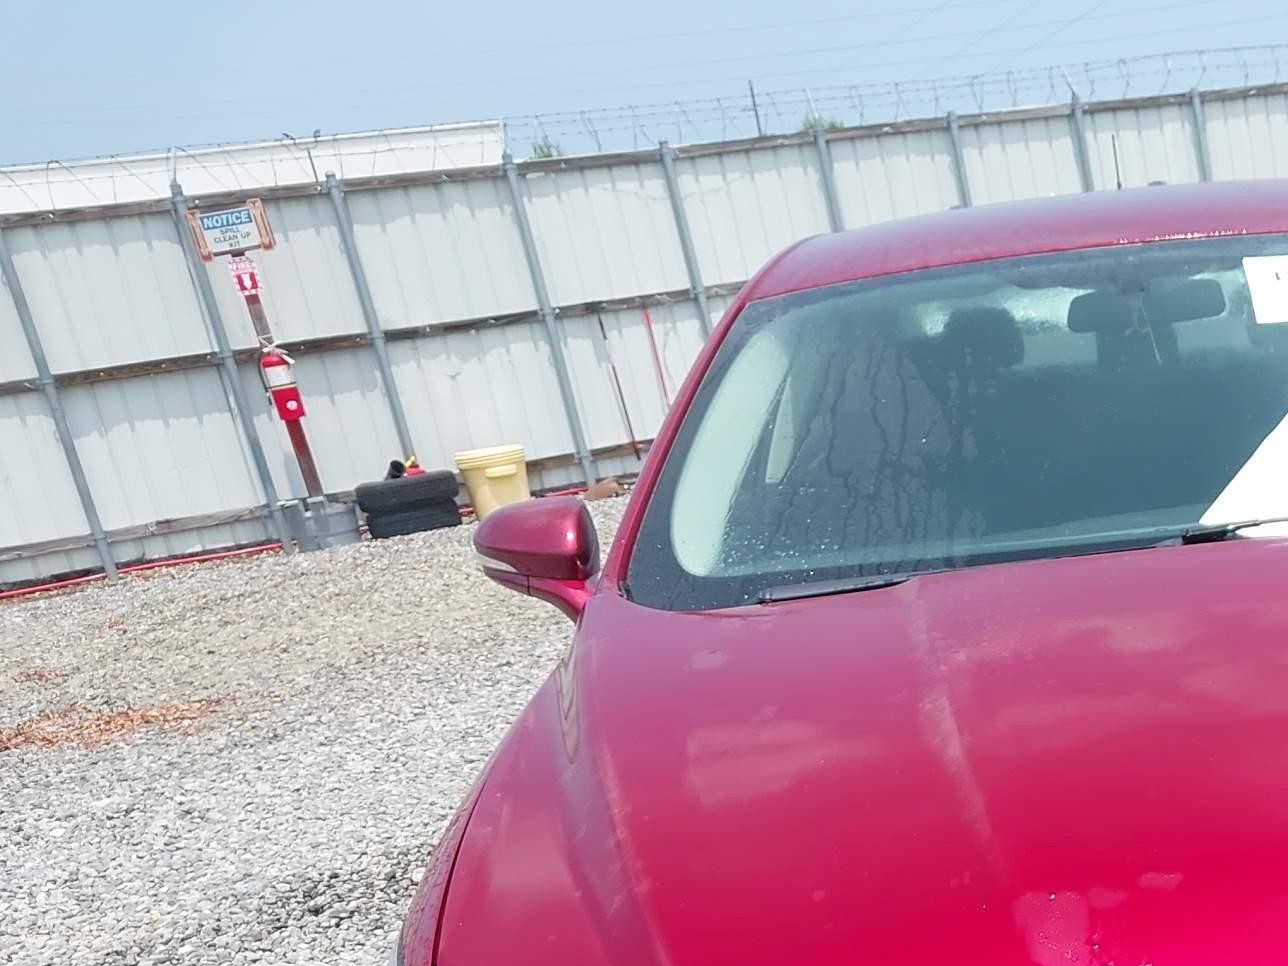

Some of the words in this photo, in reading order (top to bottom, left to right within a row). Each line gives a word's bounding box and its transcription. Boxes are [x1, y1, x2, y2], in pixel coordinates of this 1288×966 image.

[203, 210, 251, 229] NOTICE
[220, 226, 240, 235] SPILL
[214, 233, 239, 244] CLEAN
[241, 231, 251, 240] UP
